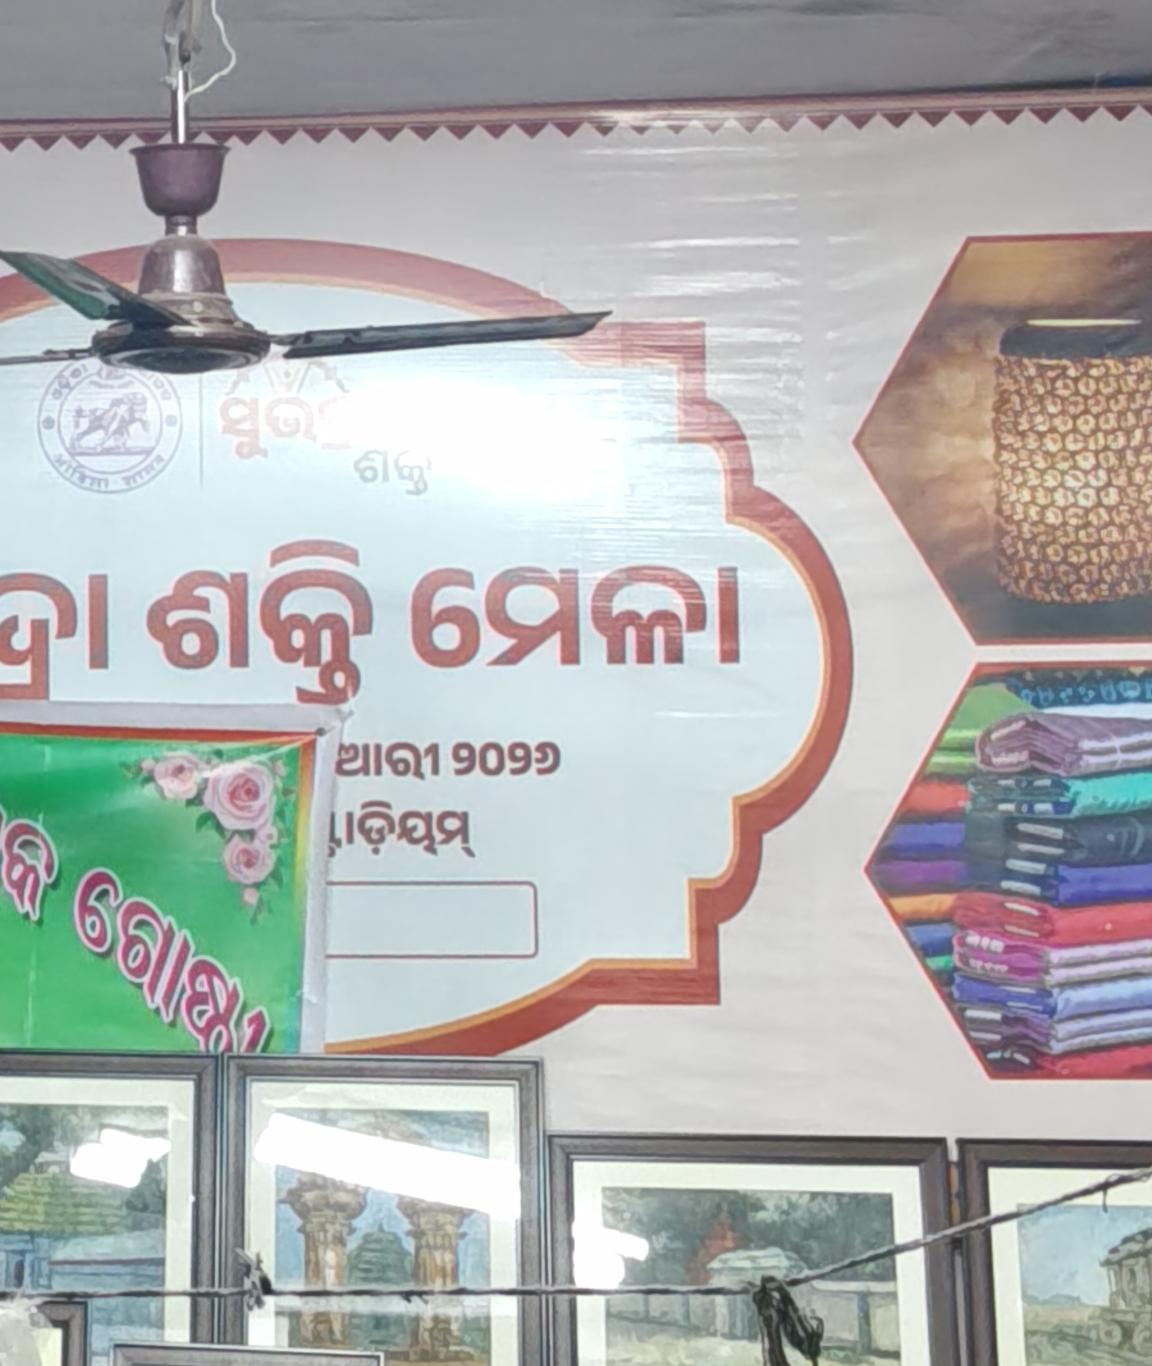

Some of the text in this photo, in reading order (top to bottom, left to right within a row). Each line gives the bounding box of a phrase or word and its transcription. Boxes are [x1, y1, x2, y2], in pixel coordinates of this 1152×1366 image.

[147, 540, 373, 704] ଶକ୍ତି
[411, 564, 741, 670] ମେଳା
[451, 742, 561, 776] ୨୦୨୬
